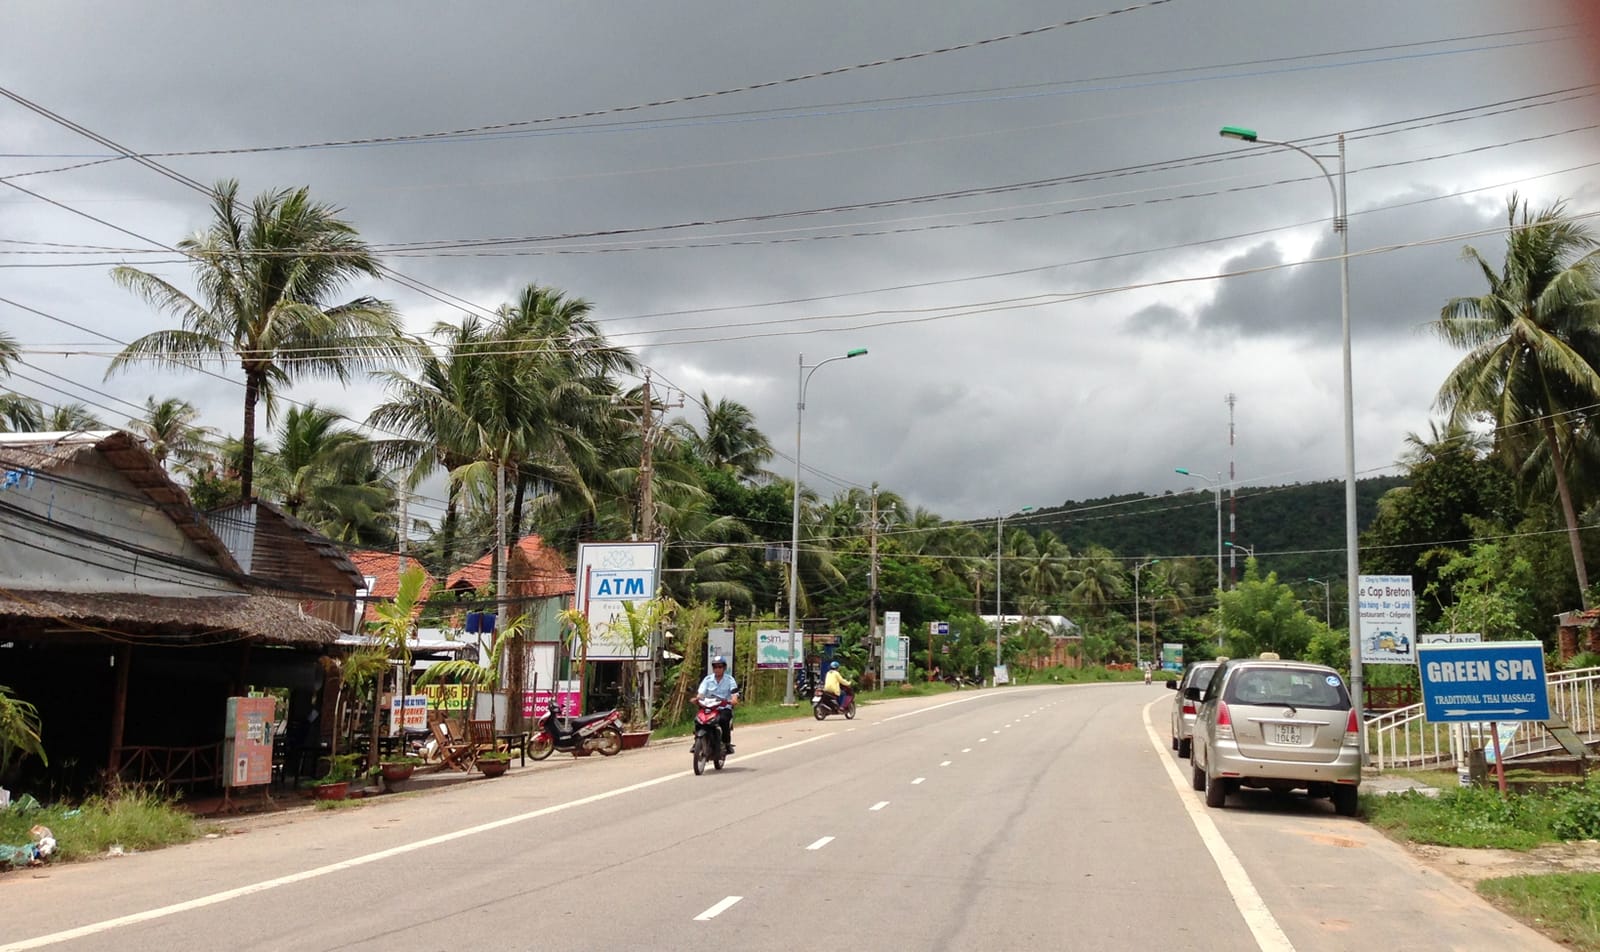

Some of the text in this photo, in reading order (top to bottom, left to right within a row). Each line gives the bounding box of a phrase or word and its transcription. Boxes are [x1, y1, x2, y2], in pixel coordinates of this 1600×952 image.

[597, 578, 644, 595] ATM
[1368, 586, 1383, 598] Cap
[1386, 586, 1410, 597] Breton
[1427, 660, 1536, 682] GREEN SPA
[1434, 693, 1536, 704] TRADITIONAL THAI MASSAGE
